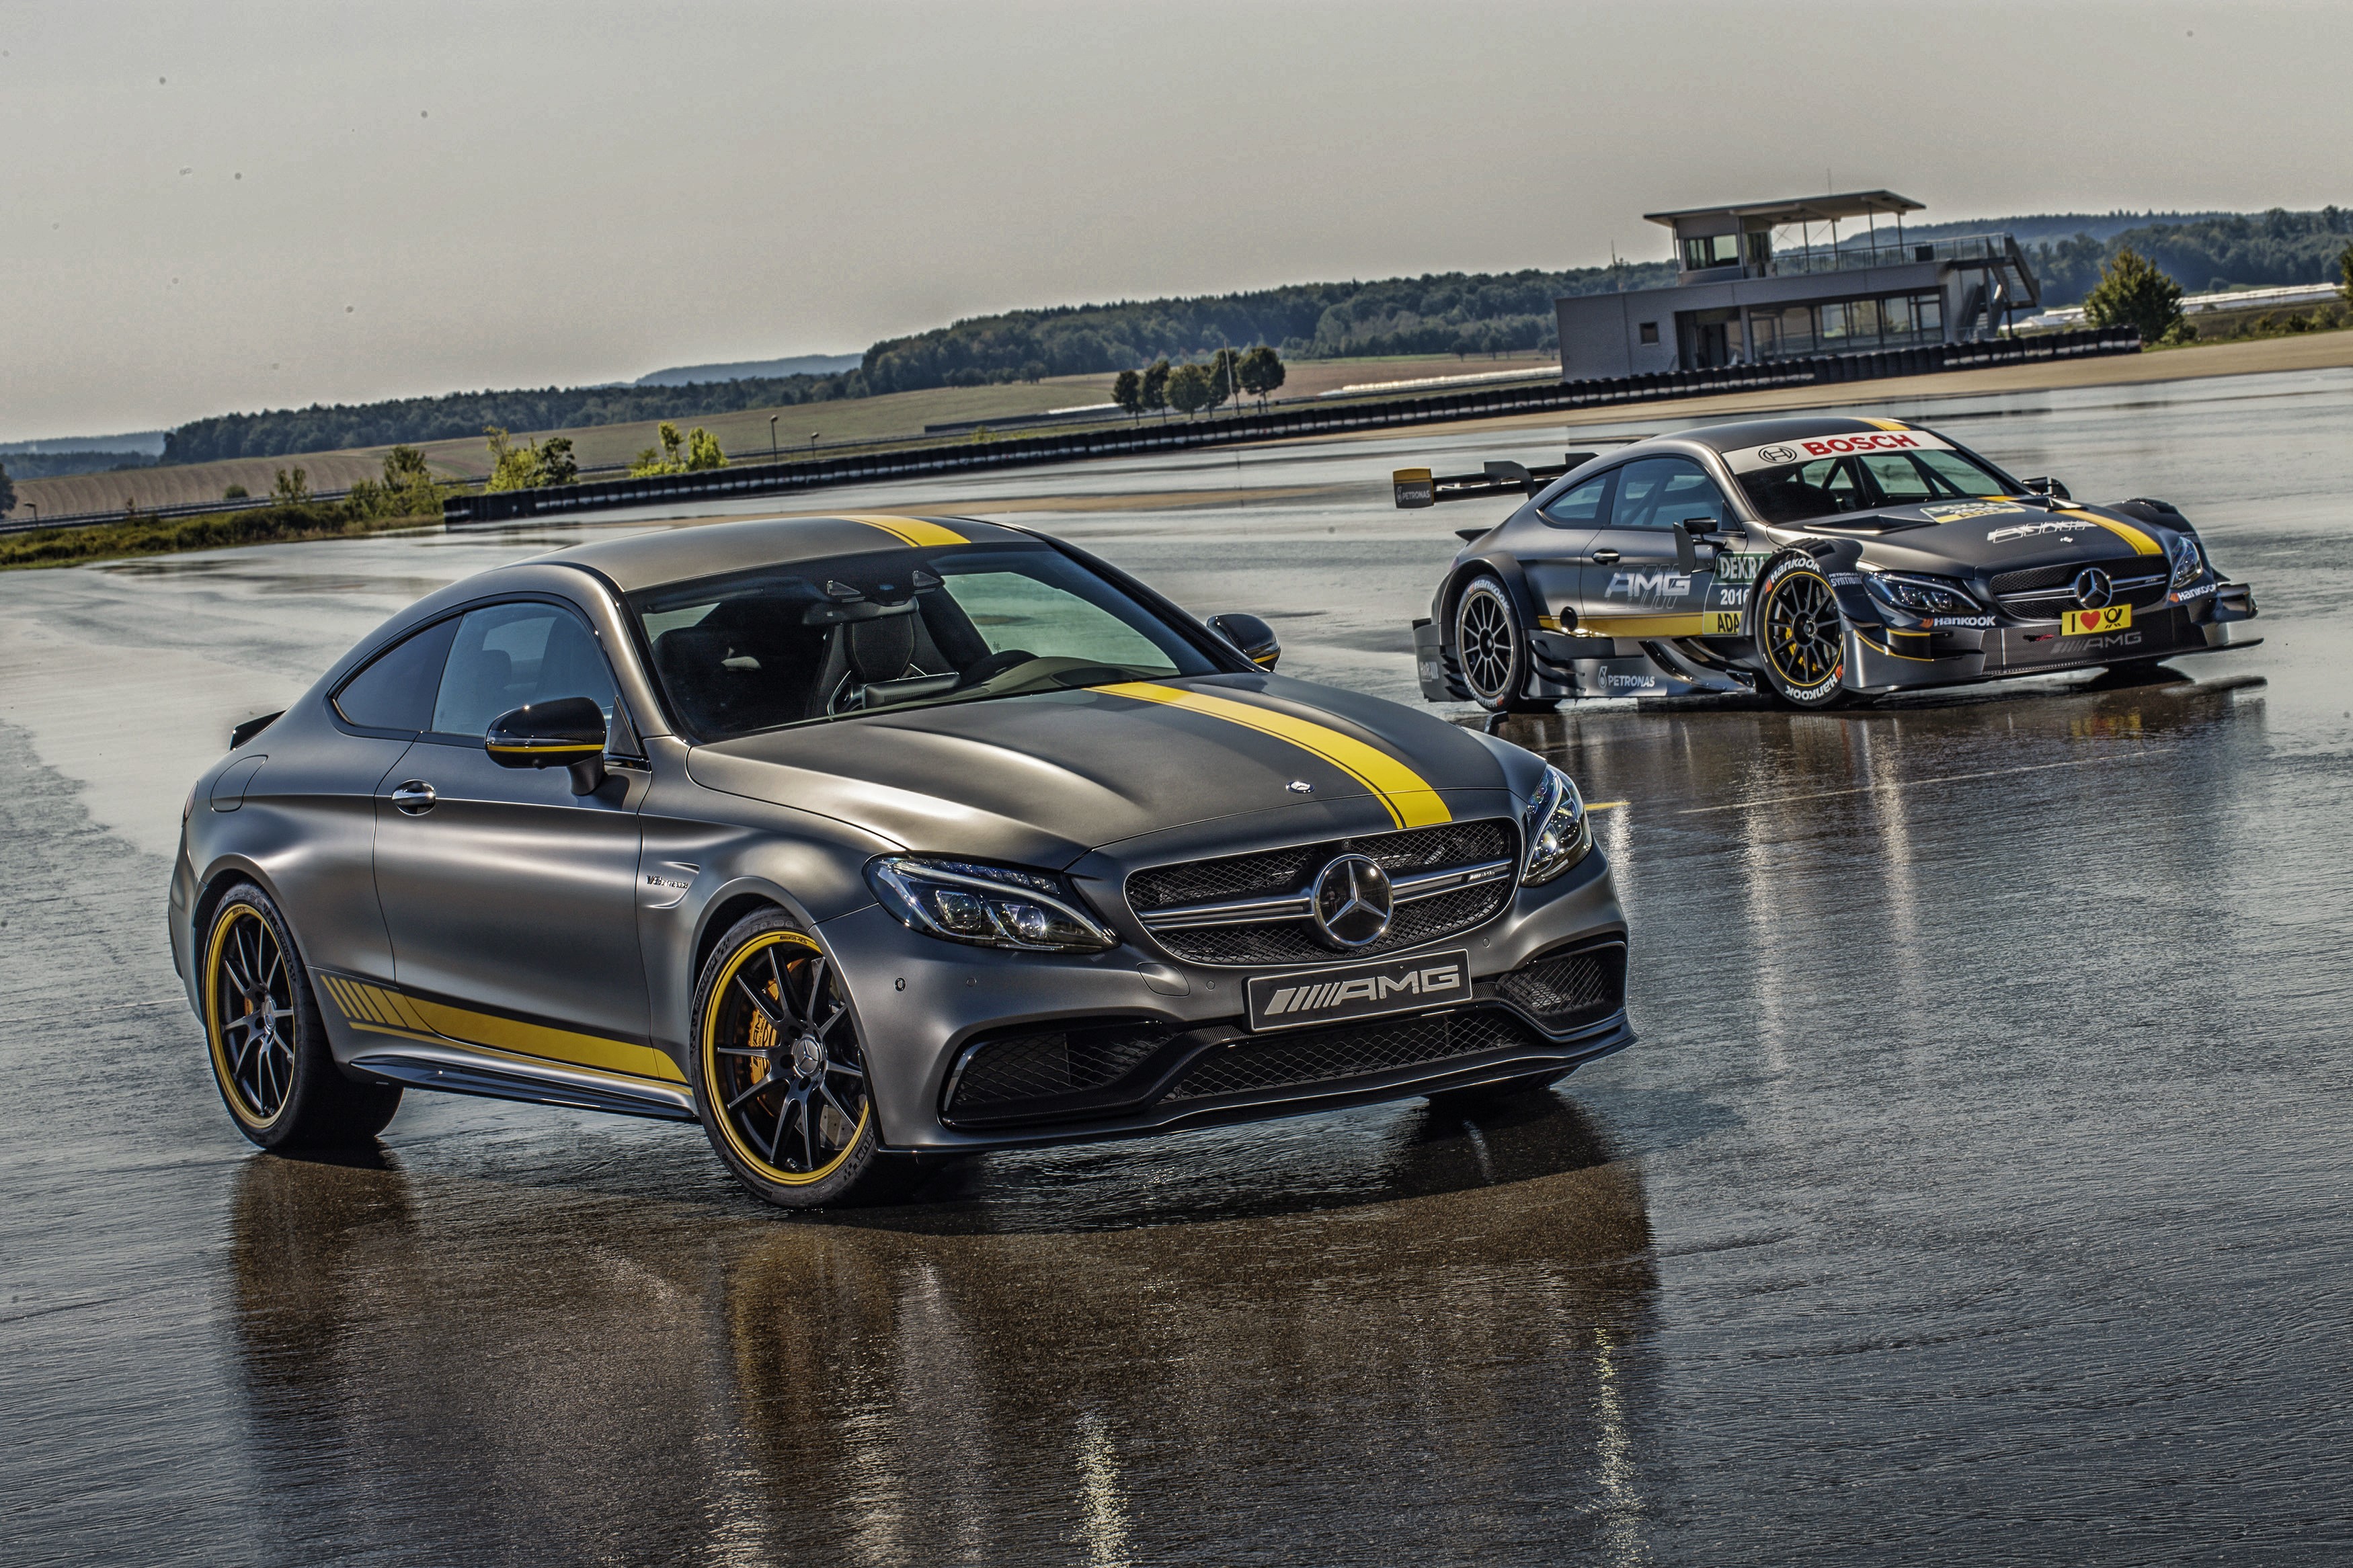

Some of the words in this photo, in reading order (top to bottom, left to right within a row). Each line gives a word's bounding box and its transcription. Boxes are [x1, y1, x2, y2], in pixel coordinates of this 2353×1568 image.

[1801, 435, 1920, 456] BOSCH
[1402, 490, 1431, 500] PETRONAS
[1604, 571, 1691, 597] AMG
[1607, 675, 1655, 687] PETRONAS
